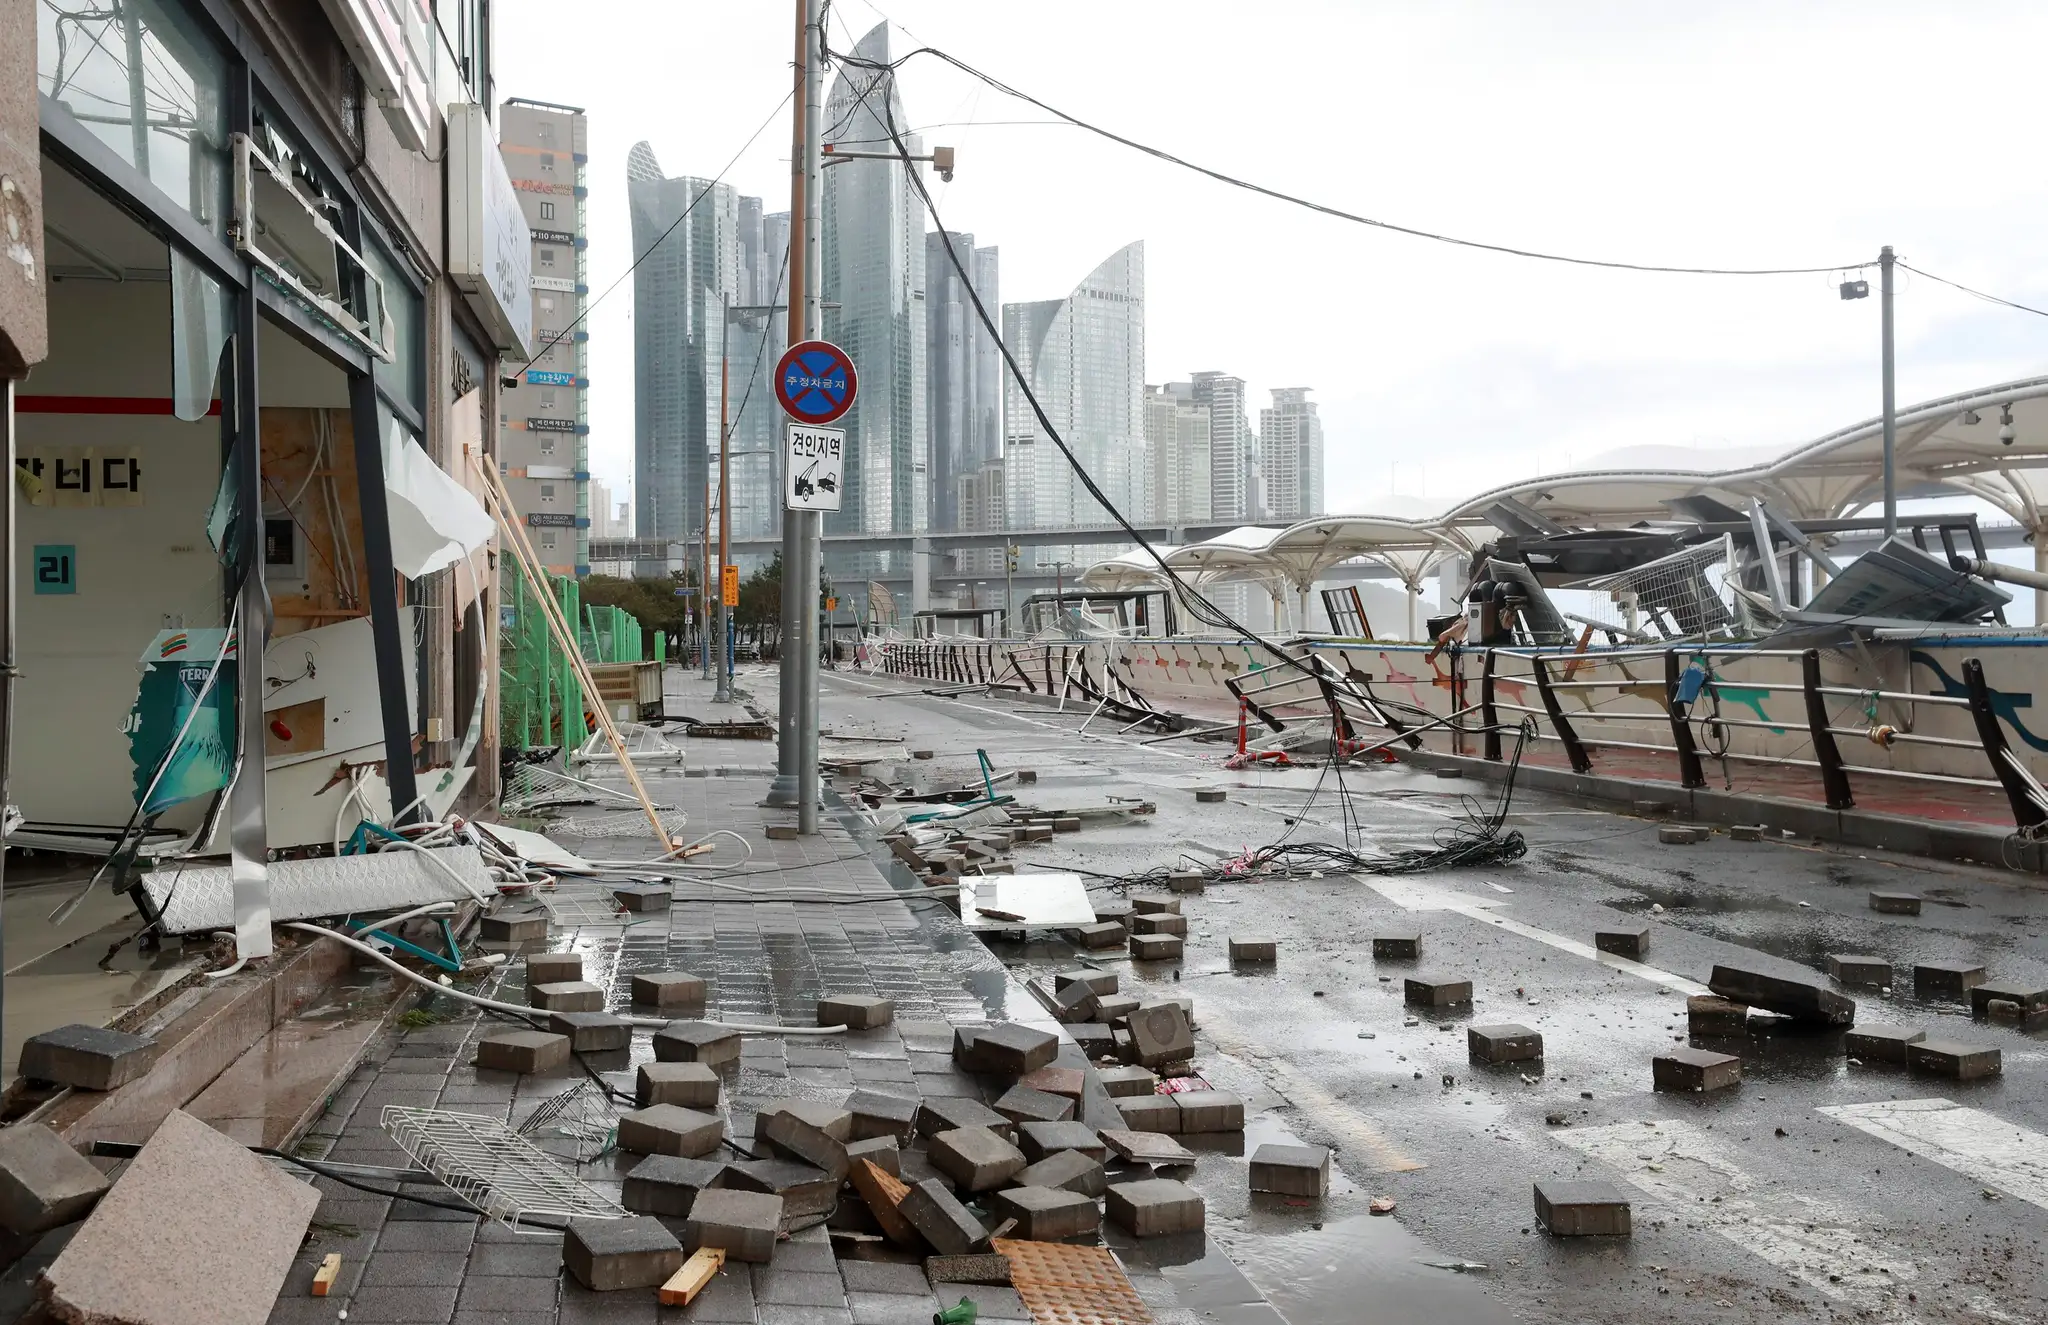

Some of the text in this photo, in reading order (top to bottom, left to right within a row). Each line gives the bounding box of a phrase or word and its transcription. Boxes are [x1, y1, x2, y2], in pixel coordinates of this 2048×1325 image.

[786, 375, 845, 389] 주정차금지
[792, 432, 841, 460] 견인지역
[38, 555, 70, 584] 리
